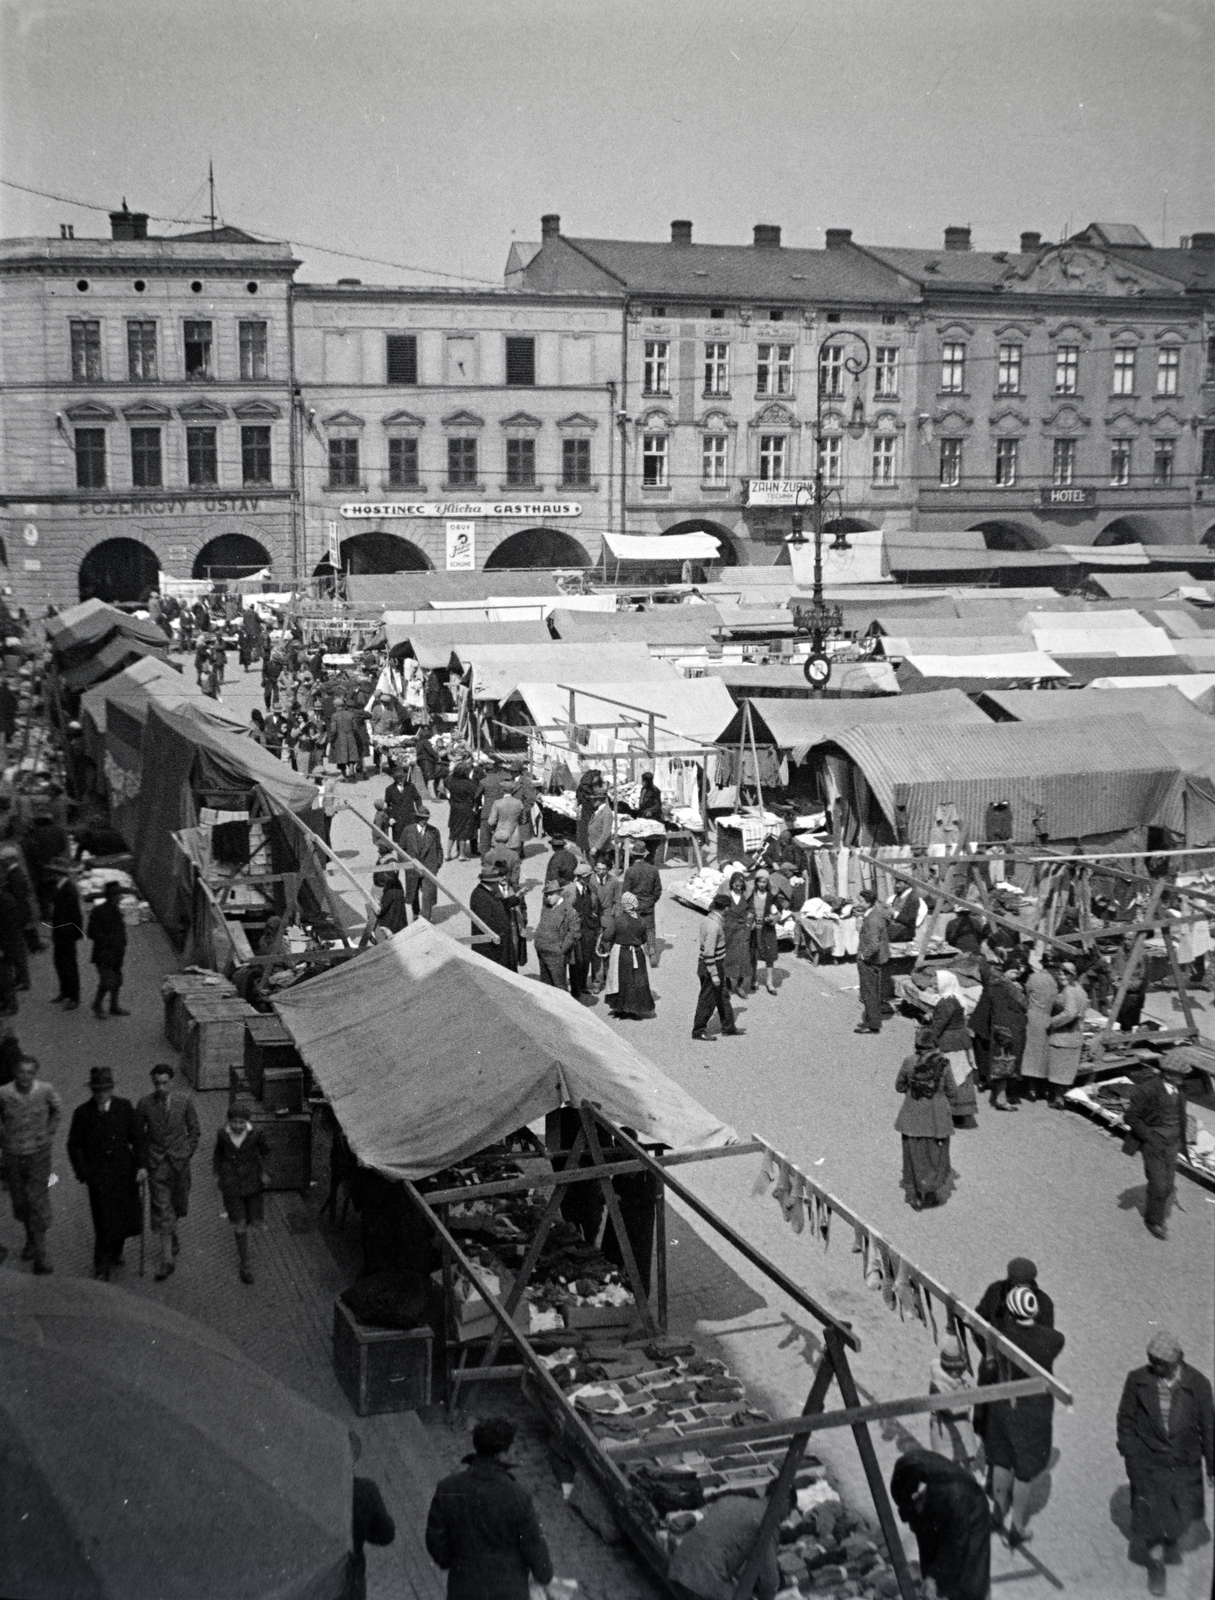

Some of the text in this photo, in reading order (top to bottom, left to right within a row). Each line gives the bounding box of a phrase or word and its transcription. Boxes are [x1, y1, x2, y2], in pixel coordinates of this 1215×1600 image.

[1050, 490, 1086, 502] HOTEL
[352, 505, 425, 515] HOSTINEC
[493, 504, 570, 514] GASTHAUS
